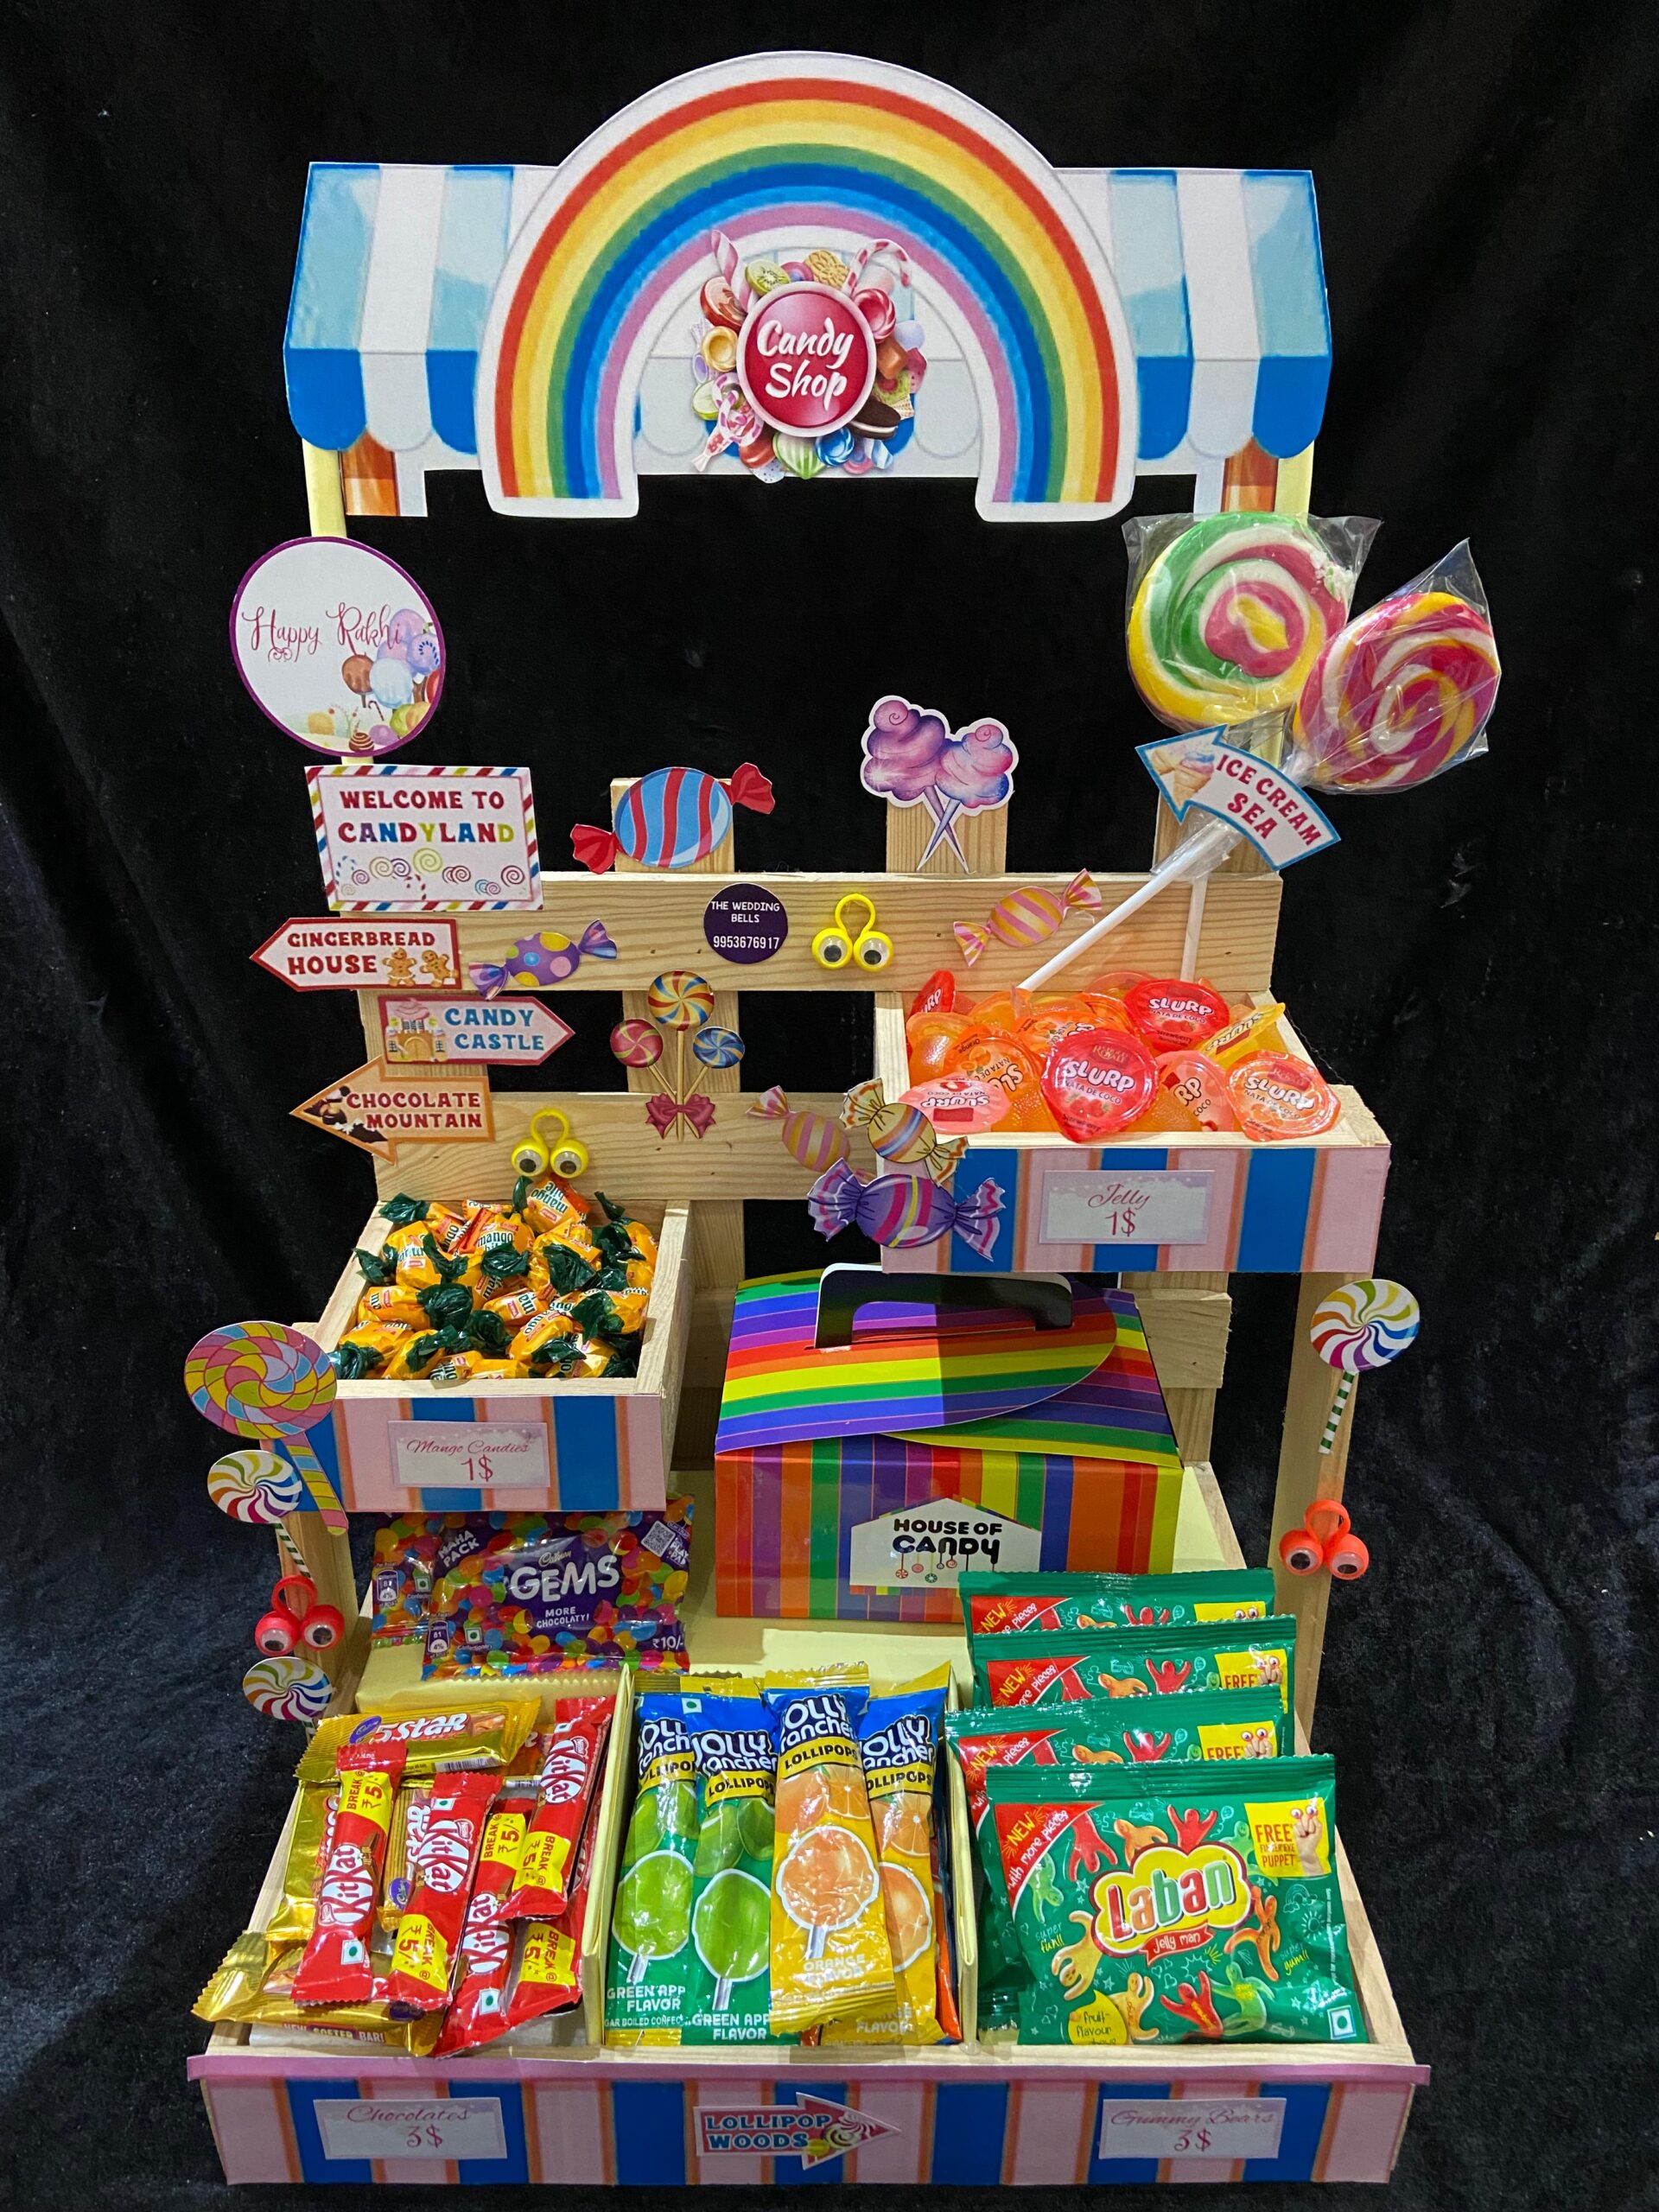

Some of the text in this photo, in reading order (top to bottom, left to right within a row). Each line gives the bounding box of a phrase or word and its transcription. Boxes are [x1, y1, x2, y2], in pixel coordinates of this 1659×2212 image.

[758, 317, 854, 370] Candy
[765, 359, 848, 410] Shop
[242, 602, 404, 662] Happy Rakhi
[340, 790, 504, 810] WELCOME TO
[1216, 753, 1321, 846] ICE CREAM
[1228, 792, 1279, 840] SEA
[338, 822, 514, 843] CANDYLAND
[711, 901, 780, 912] THE WEDDING
[731, 913, 760, 923] BELLS
[287, 931, 435, 948] GINGERBREAD
[713, 936, 779, 950] 9953676917
[287, 955, 377, 976] HOUSE
[444, 1007, 534, 1027] CANDY
[1148, 997, 1213, 1016] SLURP
[454, 1033, 544, 1051] CASTLE
[1065, 1060, 1135, 1093] SLURP
[346, 1092, 480, 1109] CHOCOLATE
[921, 1095, 990, 1109] SLURP
[1085, 1086, 1098, 1096] DE
[1098, 1091, 1122, 1105] COCO
[366, 1113, 482, 1129] MOUNTAIN
[531, 1189, 569, 1214] mango
[1088, 1183, 1151, 1210] Jelly
[1105, 1207, 1136, 1237] 1$
[477, 1230, 514, 1248] mango
[407, 1440, 530, 1456] Mango Candies
[461, 1454, 493, 1482] 1$
[893, 1518, 1002, 1535] HOUSE OF
[438, 1530, 474, 1558] MAHA
[443, 1538, 480, 1567] PACK
[510, 1555, 620, 1603] GEMS
[537, 1613, 590, 1629] CHOCOLATY!
[545, 1606, 576, 1618] MORE
[980, 1603, 1007, 1631] NEW
[1012, 1602, 1038, 1629] pieces
[999, 1667, 1027, 1698] NEW
[1031, 1664, 1057, 1694] pieces
[785, 1695, 847, 1729] OLLY
[692, 1732, 767, 1768] JOLLY
[863, 1718, 925, 1757] OLLY
[785, 1745, 858, 1770] LOLLIPOPS
[863, 1744, 934, 1770] ancher
[969, 1741, 998, 1771] NEW
[1003, 1737, 1030, 1766] pieces
[540, 1745, 587, 1803] KitKat
[867, 1770, 932, 1791] OLLIPOPS
[346, 1780, 362, 1810] BREAK
[484, 1823, 499, 1859] BREAK
[1007, 1812, 1037, 1847] NEW
[1020, 1837, 1042, 1866] more
[1041, 1808, 1069, 1841] pieces
[416, 1827, 470, 1891] KitKat
[537, 1834, 556, 1872] BREAK
[1262, 1854, 1295, 1868] PUPPET
[322, 1847, 374, 1915] KitKat
[1106, 1860, 1236, 1942] Laban
[463, 1894, 510, 1967] KitKat
[1179, 1931, 1201, 1946] man
[421, 1922, 434, 1967] BREAK
[544, 1930, 560, 1971] BREAK
[607, 1985, 654, 1999] GREEN
[626, 1998, 682, 2012] FLAVOR
[621, 2017, 650, 2026] BOILED
[691, 2013, 741, 2026] GREEN
[359, 2031, 385, 2043] BAR!
[713, 2027, 767, 2041] FLAVOR
[347, 2106, 467, 2123] Chocolates
[704, 2114, 832, 2131] LOLLIPOP
[1111, 2109, 1274, 2128] Gummy Bears
[406, 2124, 443, 2149] 3$
[708, 2133, 810, 2150] WOODS
[1174, 2127, 1212, 2152] 3$
